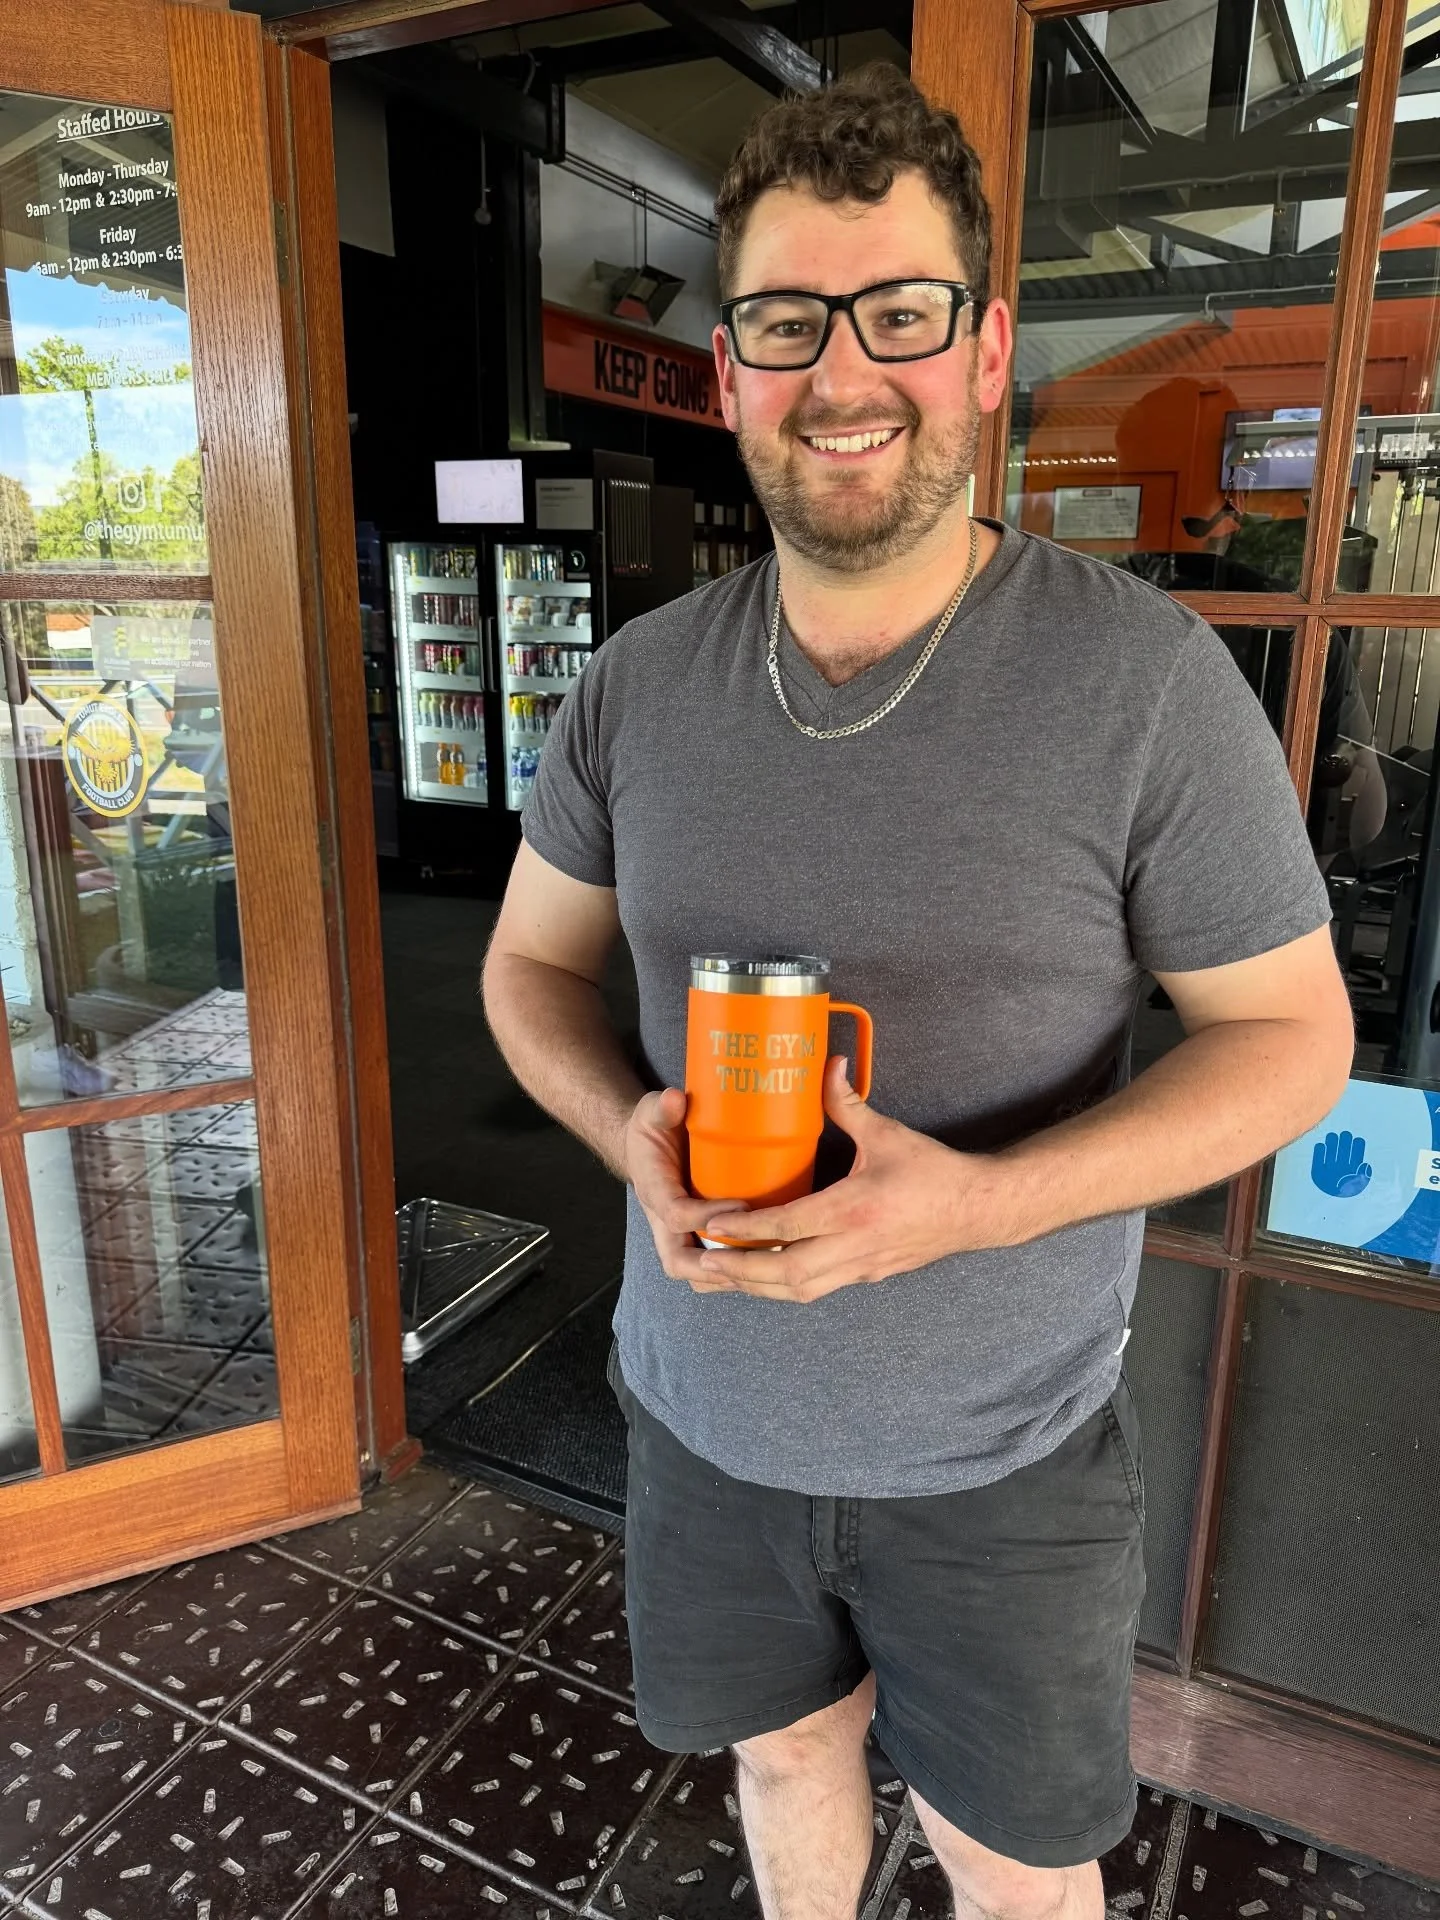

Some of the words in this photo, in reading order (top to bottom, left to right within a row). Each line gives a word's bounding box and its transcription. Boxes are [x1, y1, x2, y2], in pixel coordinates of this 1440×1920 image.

[57, 108, 111, 139] Staffed
[113, 107, 160, 130] Hours
[58, 168, 105, 189] Monday
[113, 158, 169, 180] Thursday
[25, 203, 51, 218] 9am
[58, 196, 91, 215] 12pm
[96, 192, 105, 208] &
[109, 186, 155, 206] 2:30pm
[99, 226, 137, 245] Friday
[67, 255, 100, 274] 12pm
[101, 253, 111, 269] &
[112, 248, 158, 268] 2:30pm
[594, 339, 648, 399] KEEP
[653, 357, 709, 415] GOING
[81, 783, 118, 810] FOOTBALL
[118, 789, 136, 808] CLUB
[711, 1032, 759, 1057] THE
[766, 1033, 816, 1058] GYM
[717, 1067, 808, 1093] TUMUT
